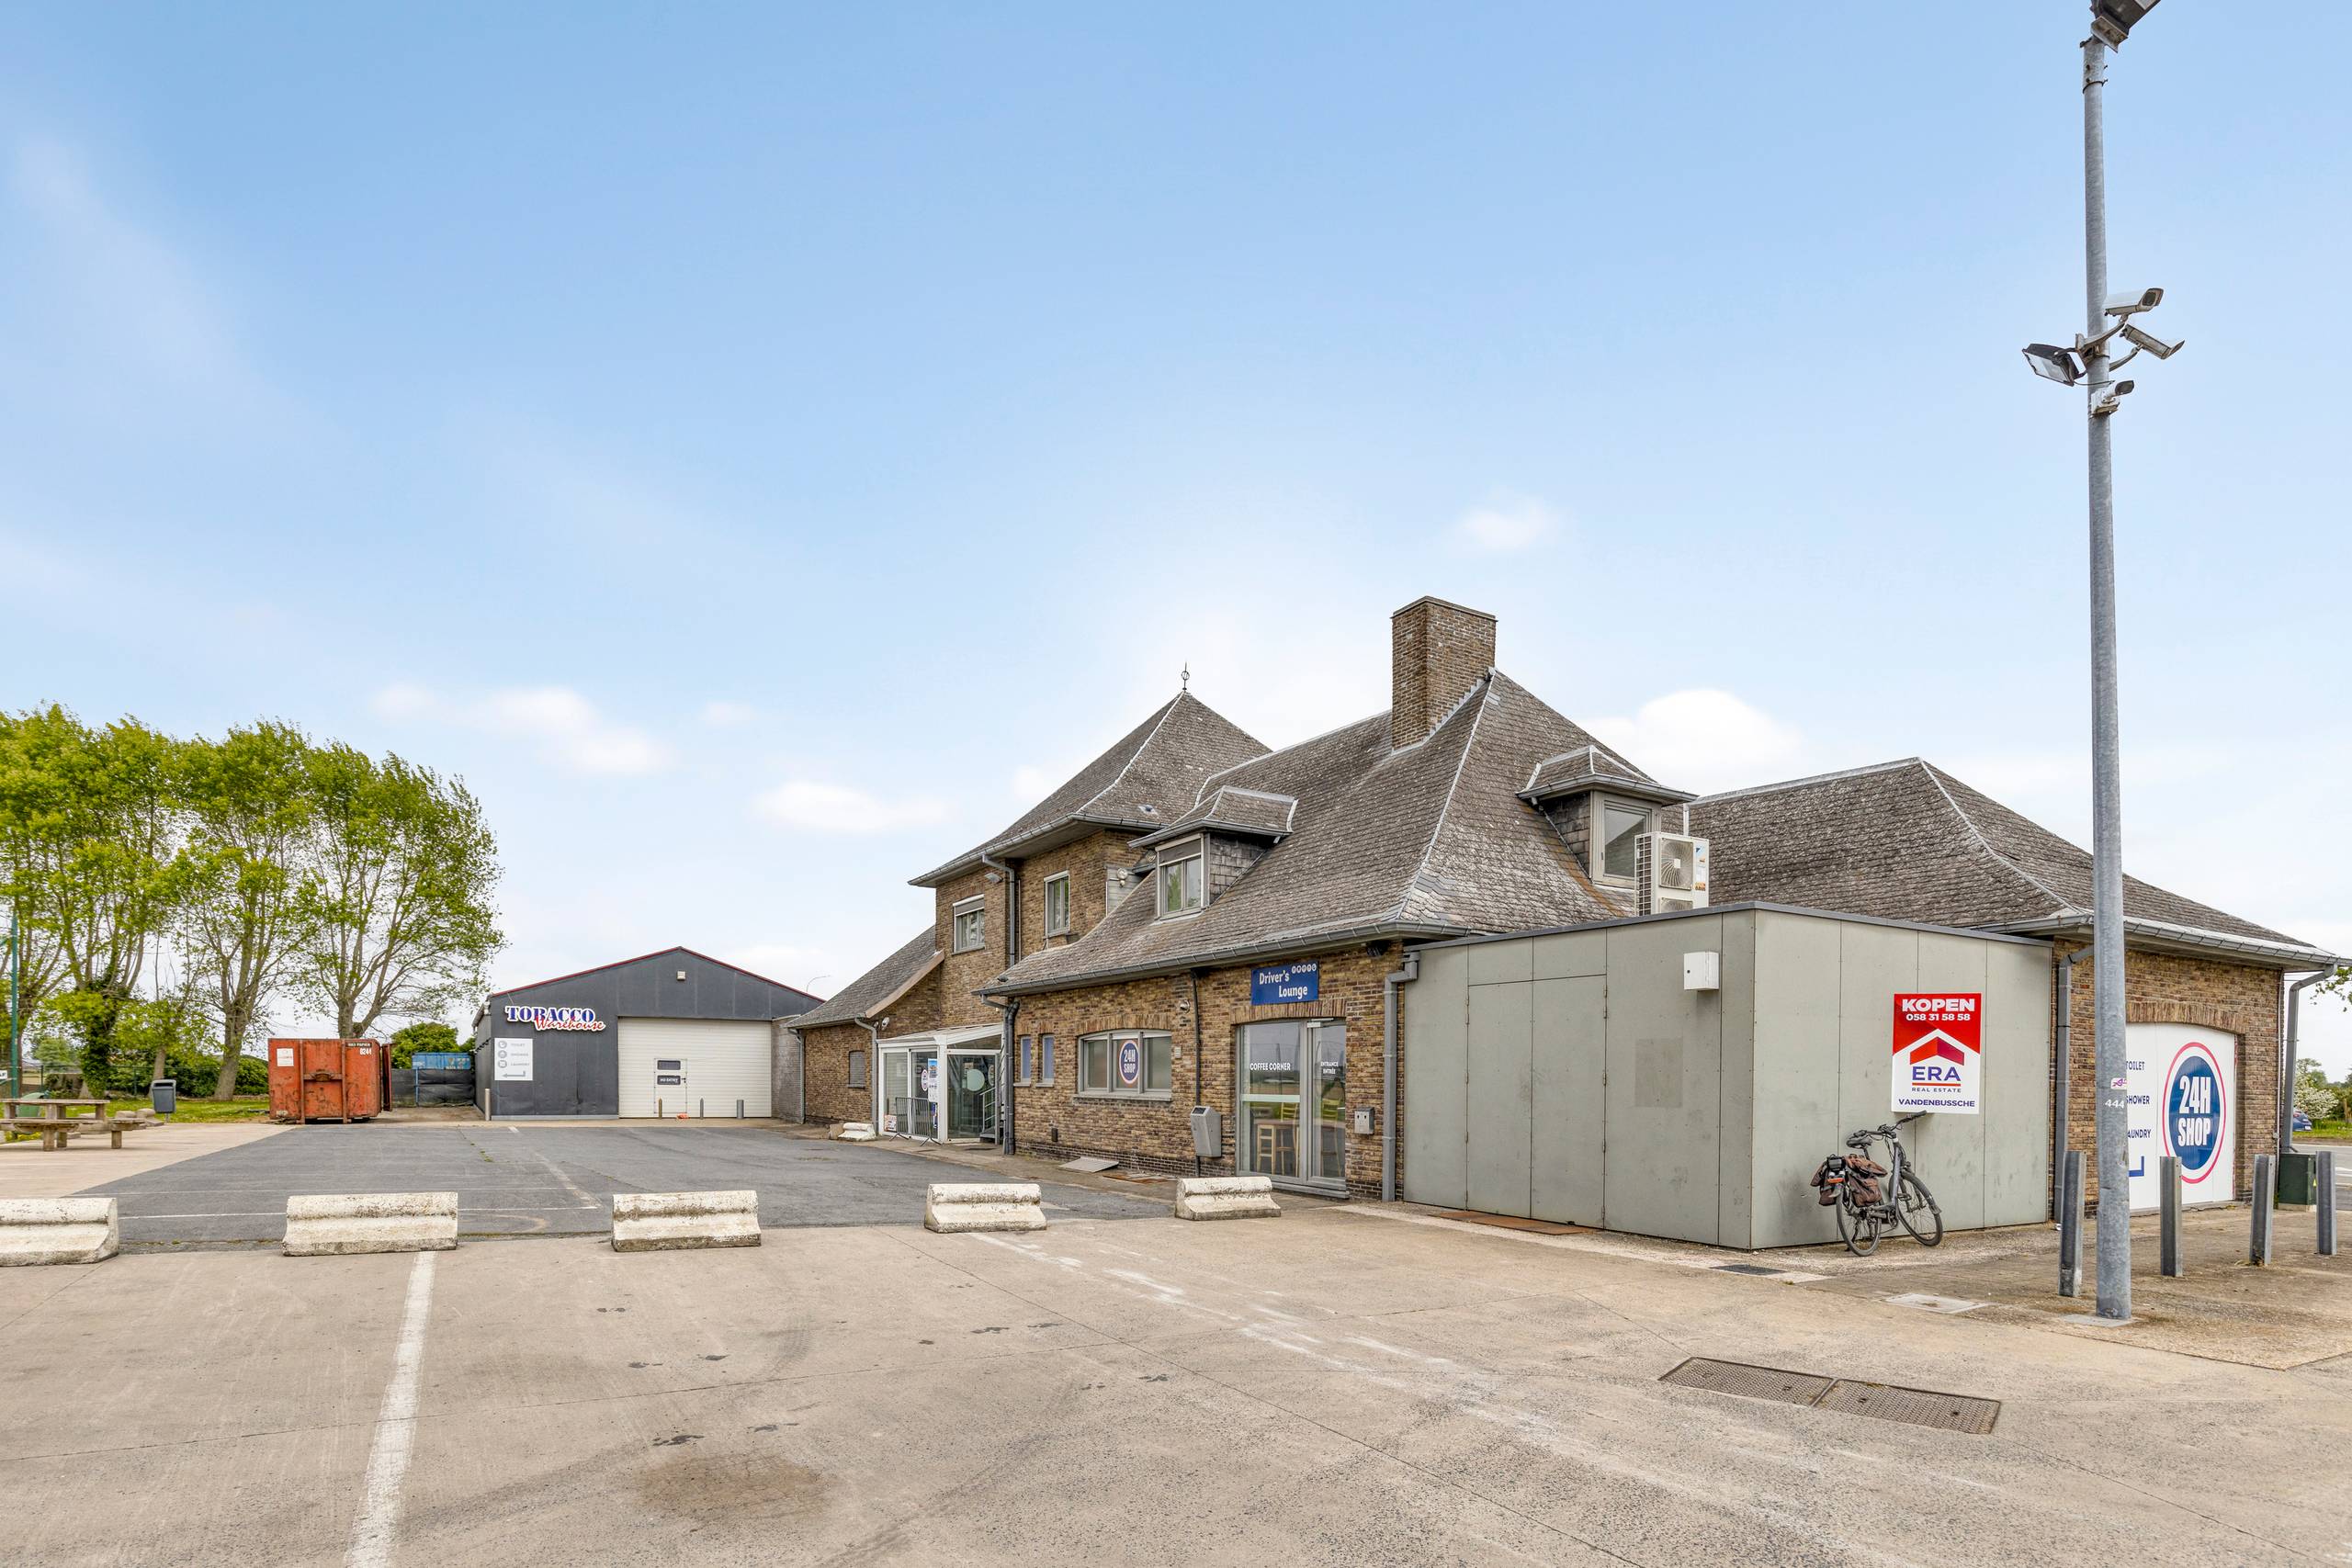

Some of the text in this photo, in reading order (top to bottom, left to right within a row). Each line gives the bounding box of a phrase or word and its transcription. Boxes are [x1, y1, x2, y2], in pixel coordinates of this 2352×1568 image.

[1260, 970, 1289, 985] Driver's
[1279, 986, 1307, 999] Lounge
[1902, 998, 1975, 1012] KOPEN
[505, 1006, 595, 1022] TOBACCO
[1905, 1013, 1971, 1021] 058 31 58 58
[534, 1016, 605, 1031] Warehouse
[1124, 1049, 1136, 1063] 24H
[1124, 1063, 1136, 1074] SHOP
[1250, 1062, 1291, 1071] COFFEE CORNER
[1912, 1066, 1962, 1081] ERA
[2178, 1075, 2211, 1114] 24H
[1898, 1099, 1975, 1107] VANDENBUSSCHE
[2127, 1129, 2152, 1139] AUNDRY
[2177, 1117, 2211, 1147] SHOP
